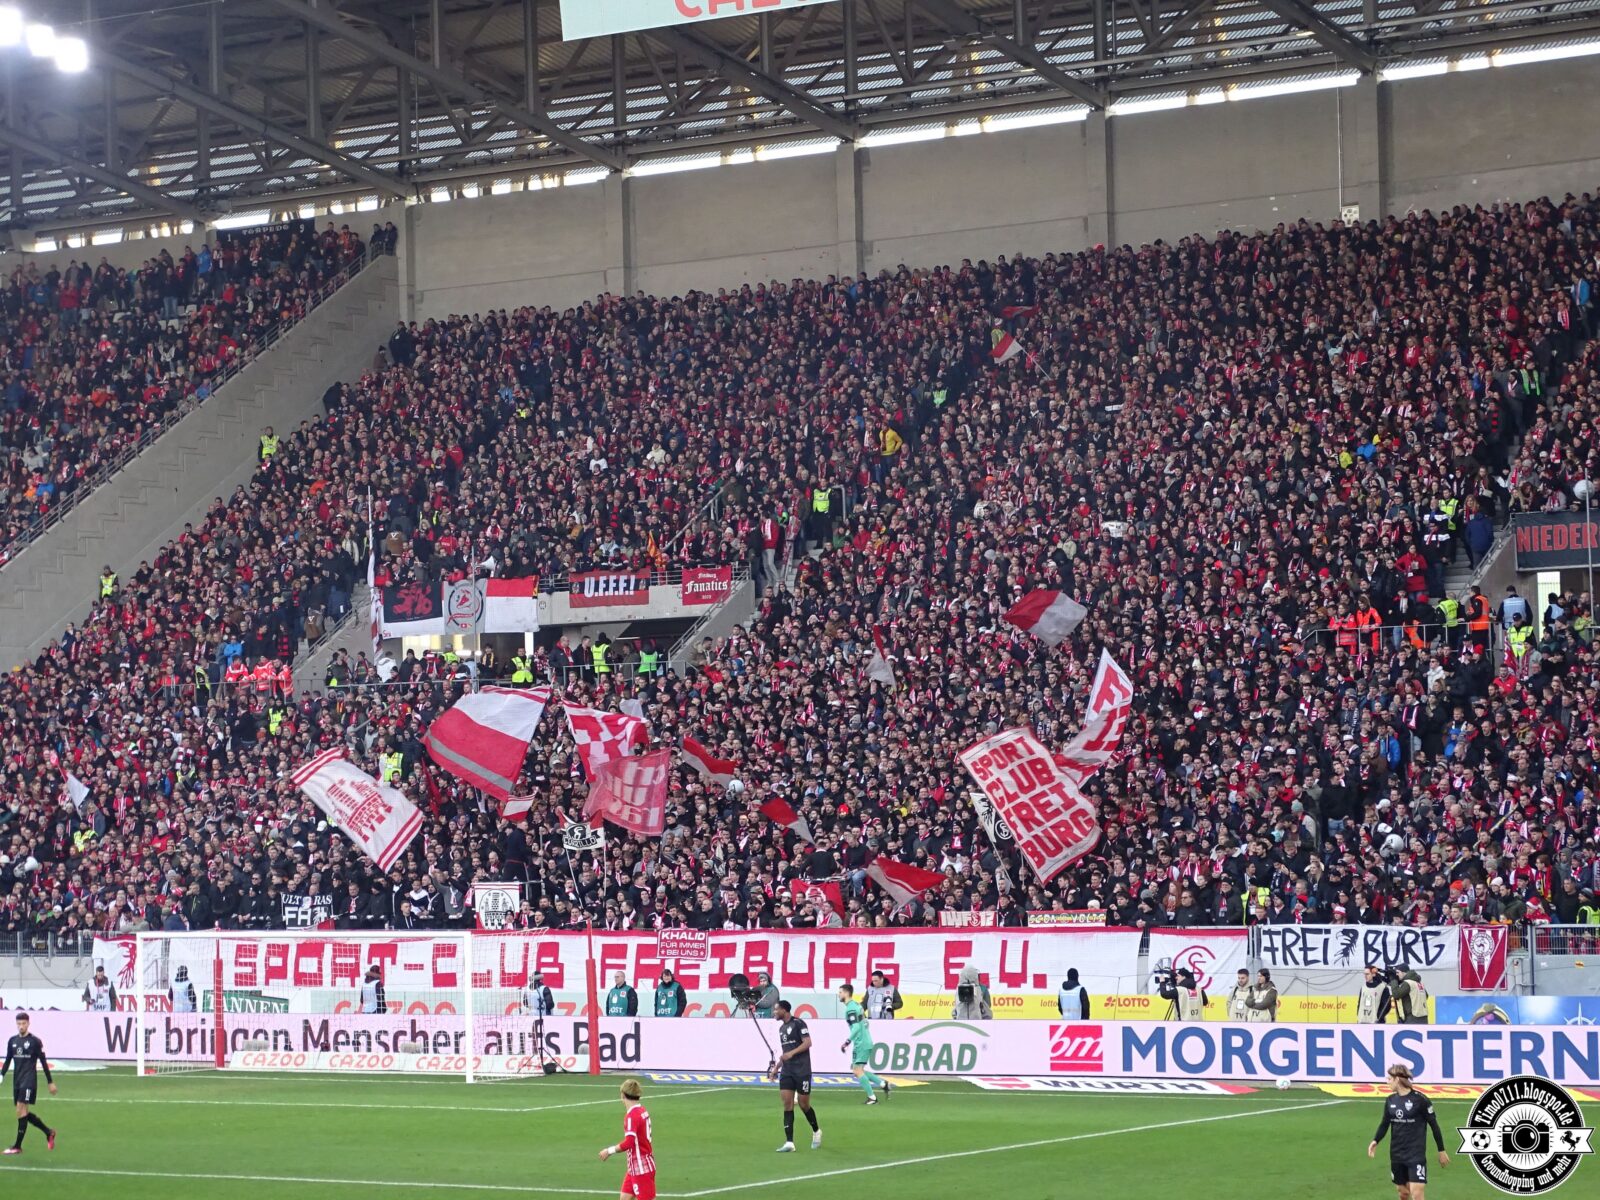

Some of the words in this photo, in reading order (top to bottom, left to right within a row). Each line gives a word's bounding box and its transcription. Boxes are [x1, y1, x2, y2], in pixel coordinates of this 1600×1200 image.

[1516, 522, 1599, 552] NIEDER
[685, 578, 729, 595] Fanatics
[970, 735, 1036, 781] SPORT
[985, 757, 1056, 809] CLUB
[1002, 781, 1078, 842] FREI
[1020, 807, 1096, 869] BURG
[660, 941, 677, 949] FÜR
[661, 932, 706, 941] KHALID
[1363, 929, 1446, 967] BURG
[600, 939, 900, 991] FREIBURG
[680, 949, 699, 957] UNS
[993, 997, 1024, 1007] LOTTO
[1117, 997, 1150, 1008] LOTTO
[1299, 1000, 1347, 1010] lotto-bw.de
[103, 1016, 157, 1055] Wir
[1050, 1025, 1104, 1058] bm
[242, 1053, 307, 1067] CAZOO
[328, 1054, 394, 1069] CAZOO
[869, 1041, 978, 1072] OBRAD
[1121, 1025, 1600, 1081] MORGENSTERN
